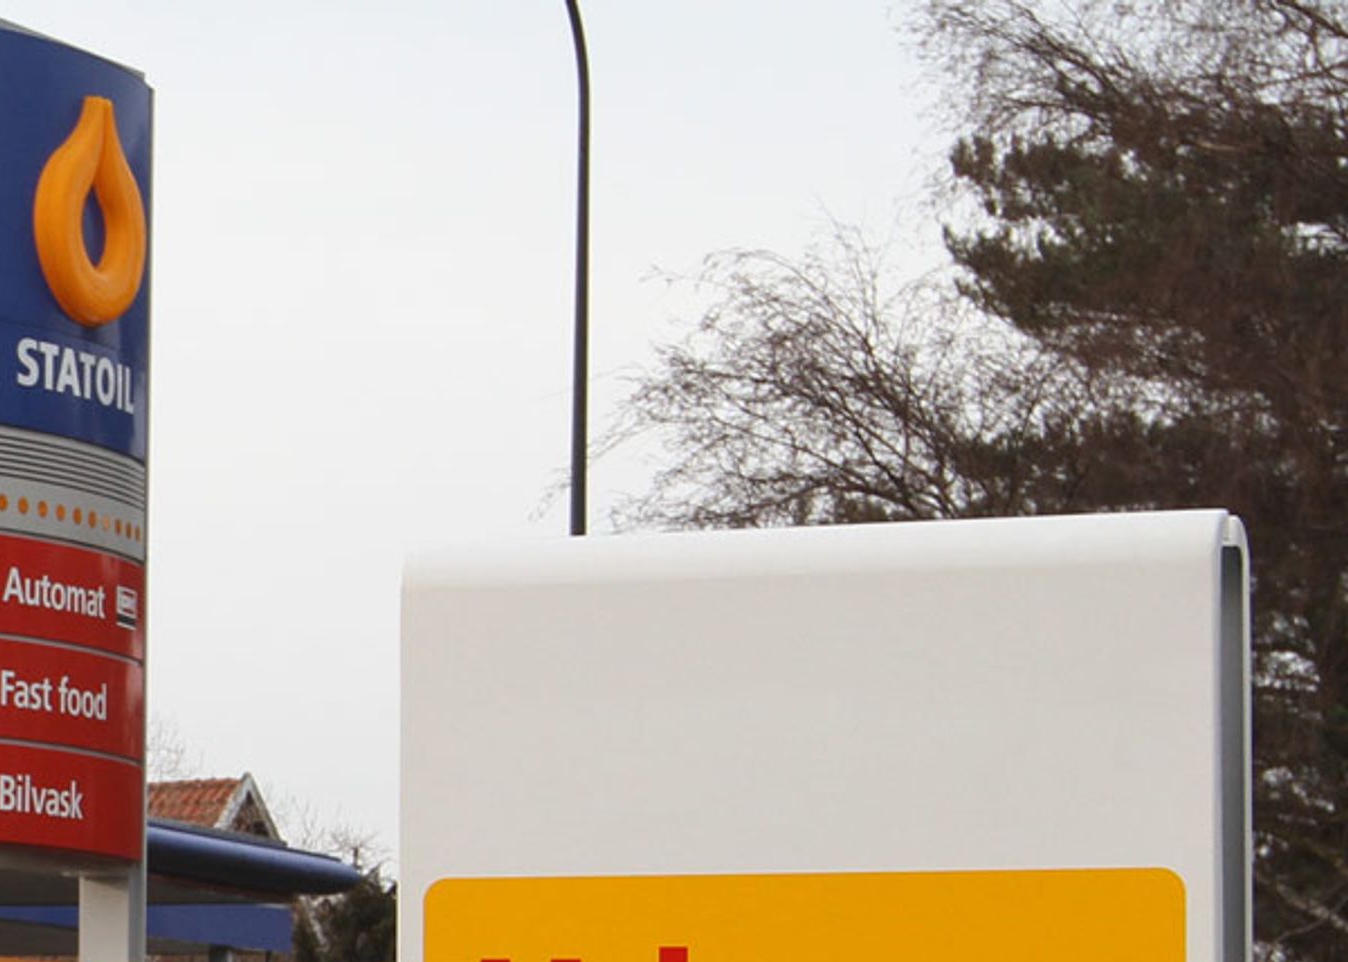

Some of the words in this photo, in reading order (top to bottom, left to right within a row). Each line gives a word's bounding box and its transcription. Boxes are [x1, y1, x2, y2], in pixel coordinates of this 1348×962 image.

[17, 337, 134, 415] STATOIL
[3, 566, 106, 619] Automat
[0, 670, 52, 712] Fast
[58, 676, 108, 720] food
